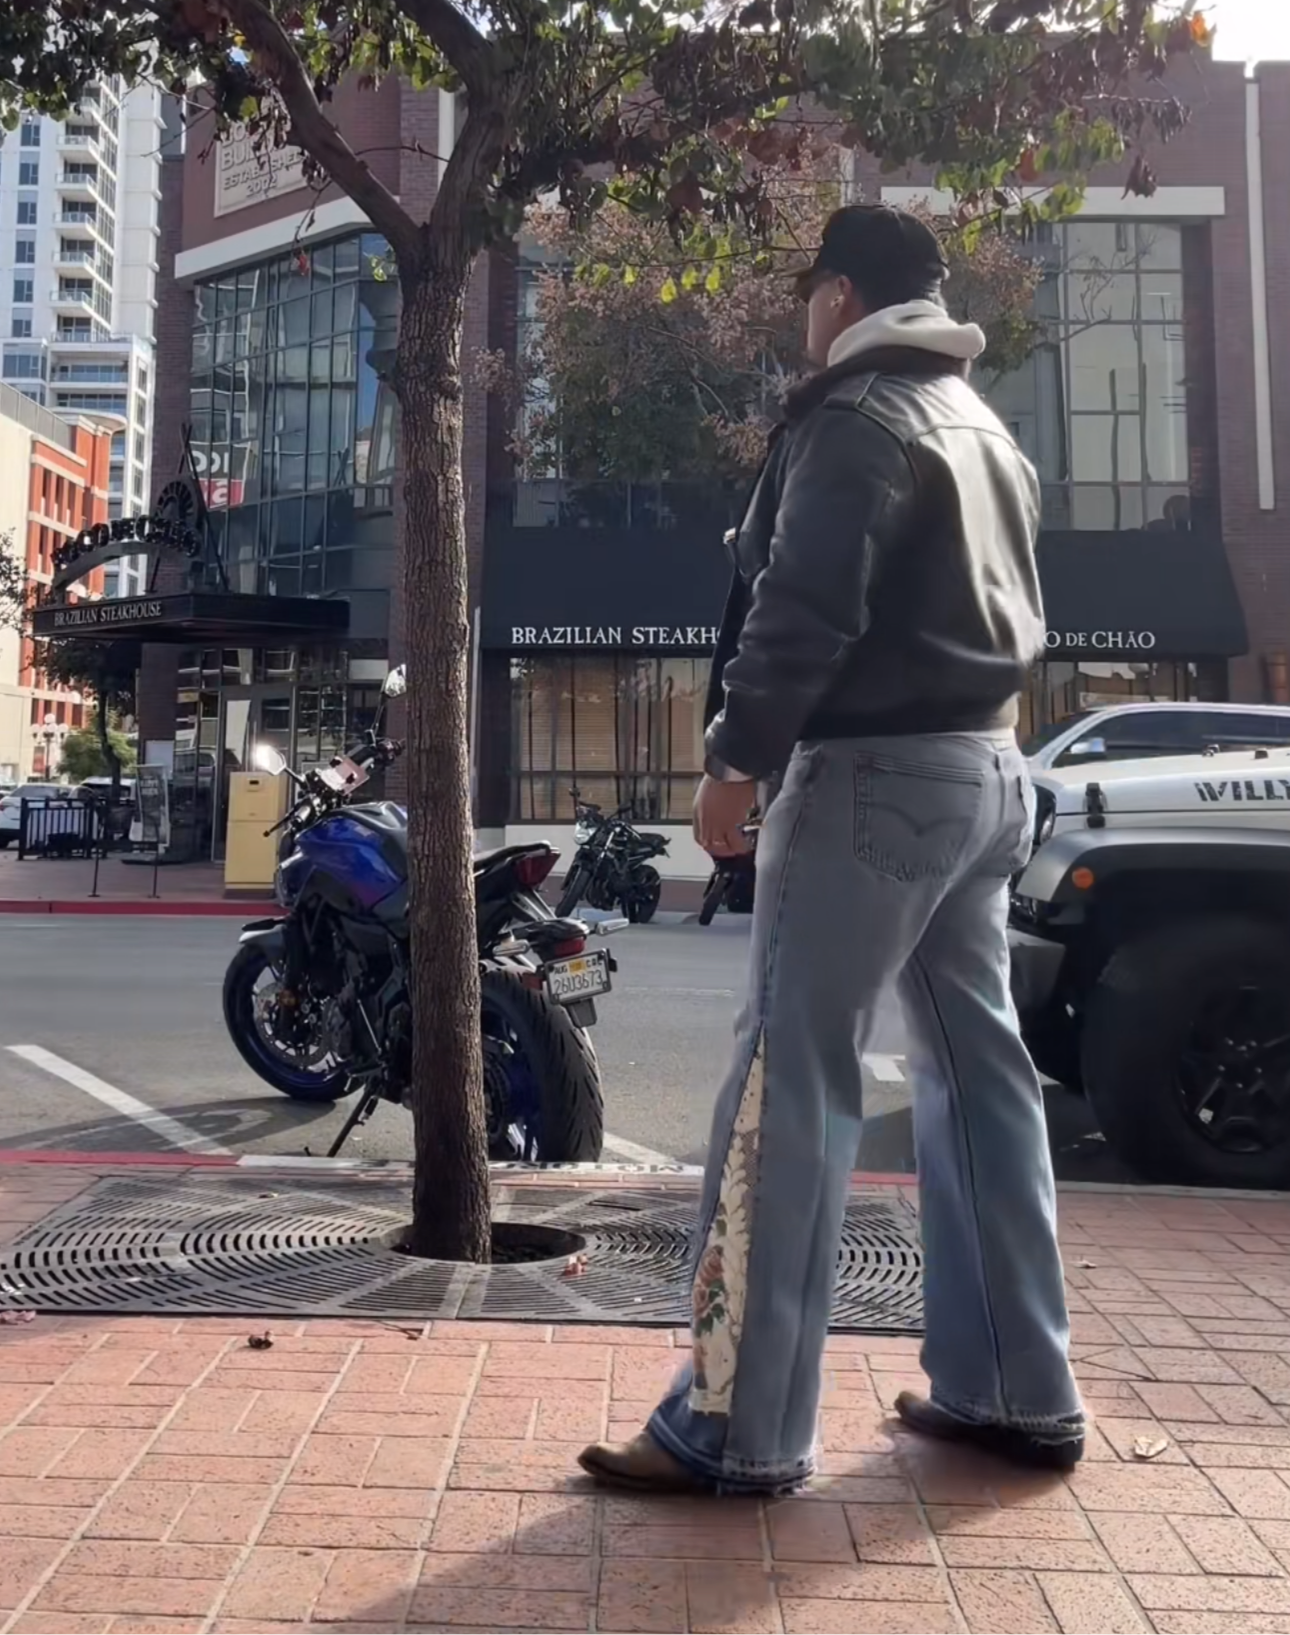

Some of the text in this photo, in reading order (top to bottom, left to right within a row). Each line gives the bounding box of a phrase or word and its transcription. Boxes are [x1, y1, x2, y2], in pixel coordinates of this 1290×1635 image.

[54, 601, 162, 626] BRAZILIAN STEAKHOUSE
[511, 627, 720, 644] BRAZILIAN STEAKH
[1065, 632, 1088, 647] DE
[554, 969, 603, 996] 26U3673
